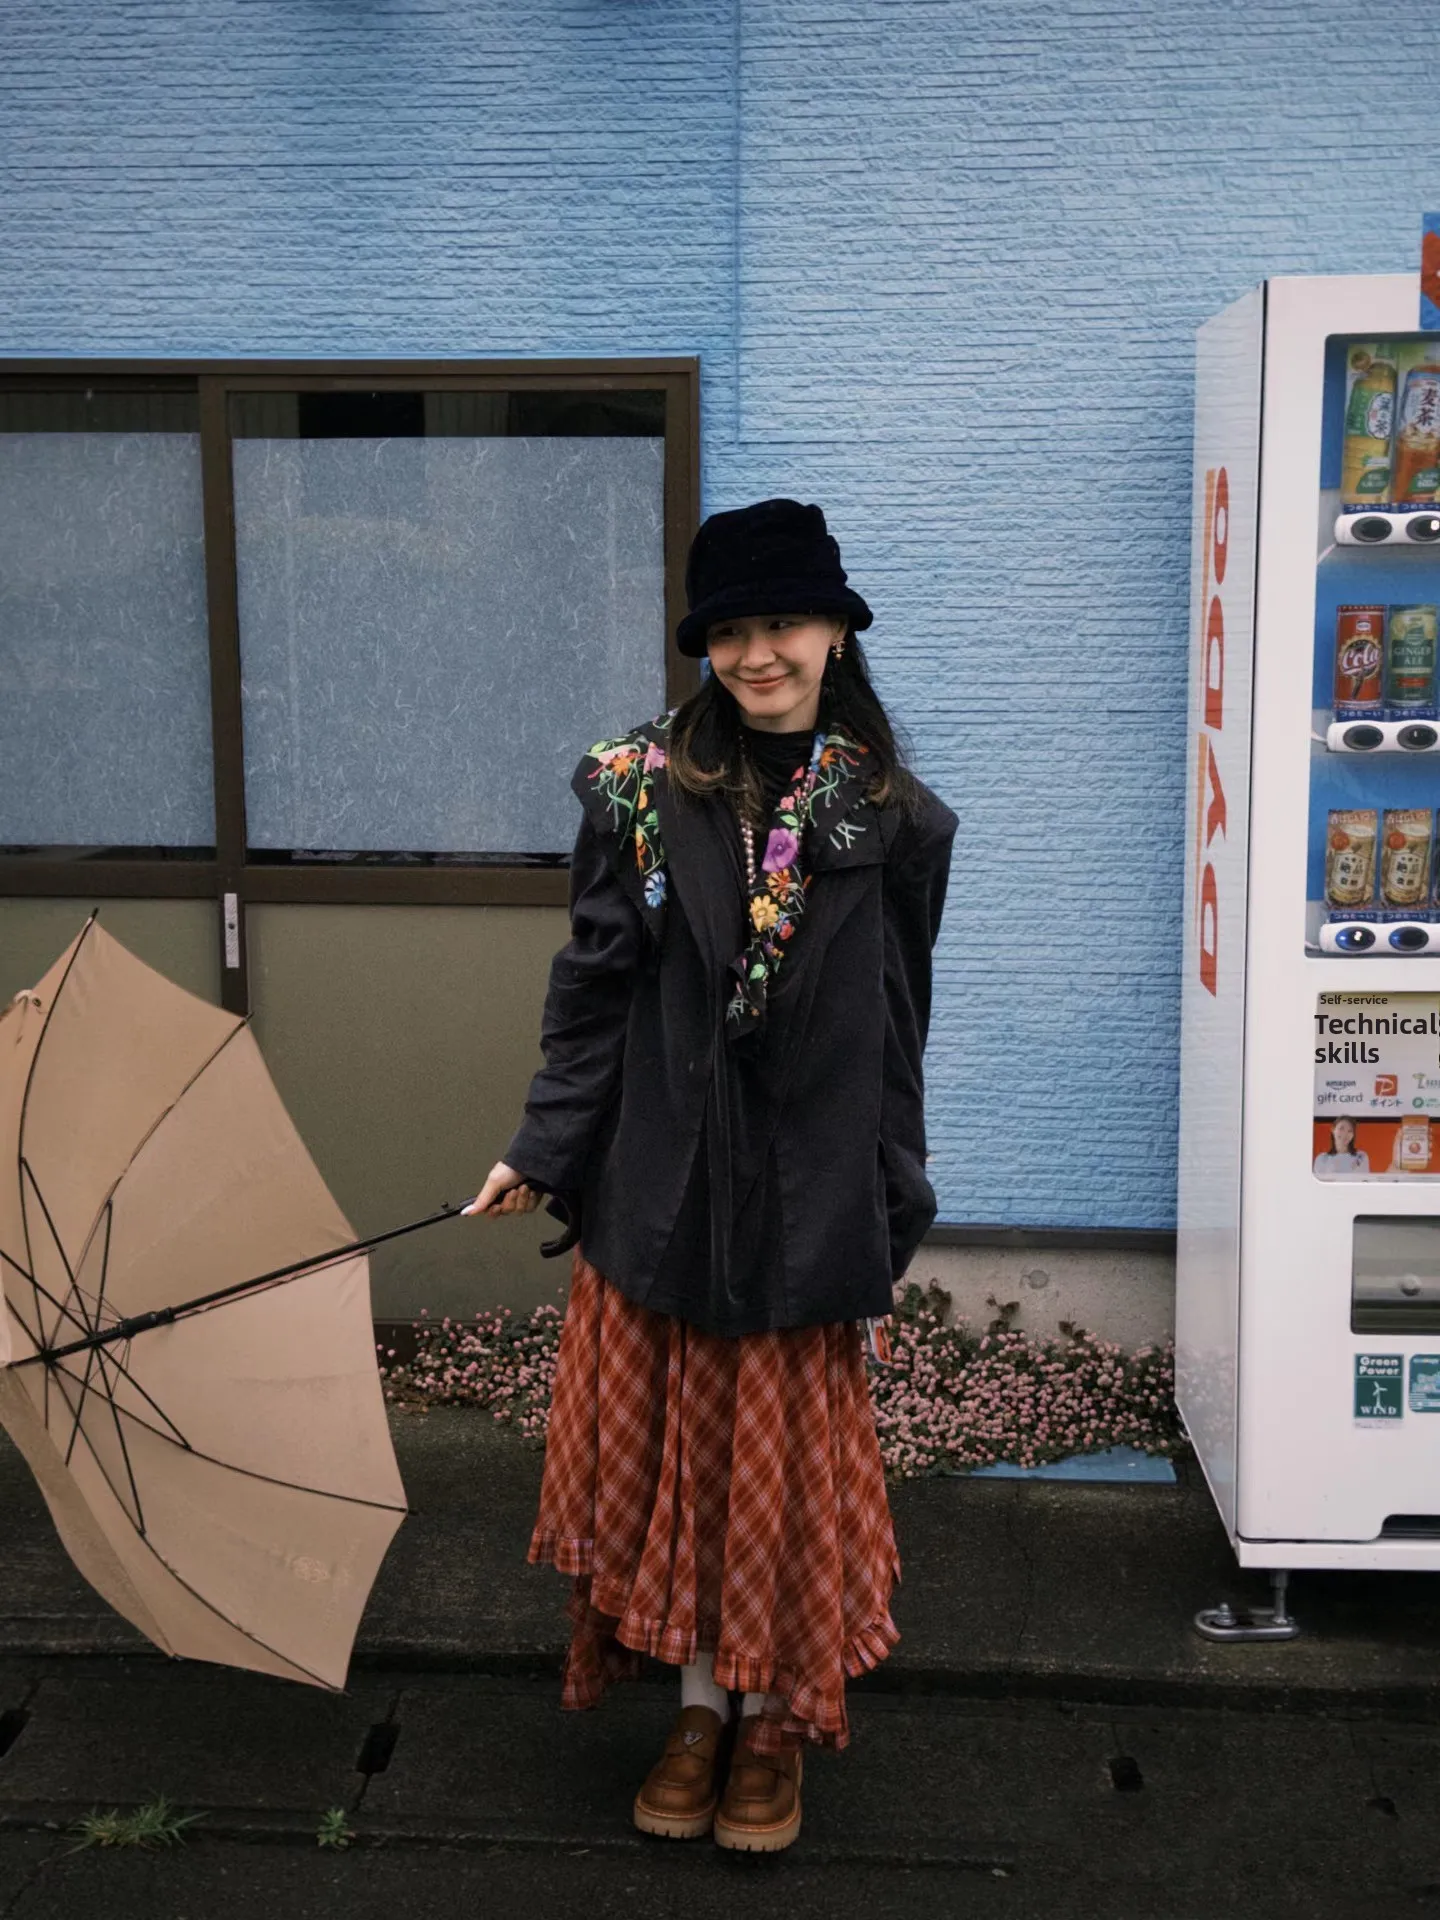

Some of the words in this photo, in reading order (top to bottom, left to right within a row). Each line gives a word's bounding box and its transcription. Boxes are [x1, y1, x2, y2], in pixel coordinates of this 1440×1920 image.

[1416, 388, 1440, 425] 麦茶
[1342, 643, 1380, 672] Cola
[1404, 656, 1424, 665] ALE
[1326, 1080, 1357, 1088] amazon
[1317, 1091, 1337, 1105] gift
[1339, 1092, 1363, 1103] card
[1370, 1099, 1403, 1108] ポイント
[1360, 1356, 1399, 1366] Green
[1359, 1366, 1400, 1375] Power
[1360, 1405, 1397, 1415] WIND
